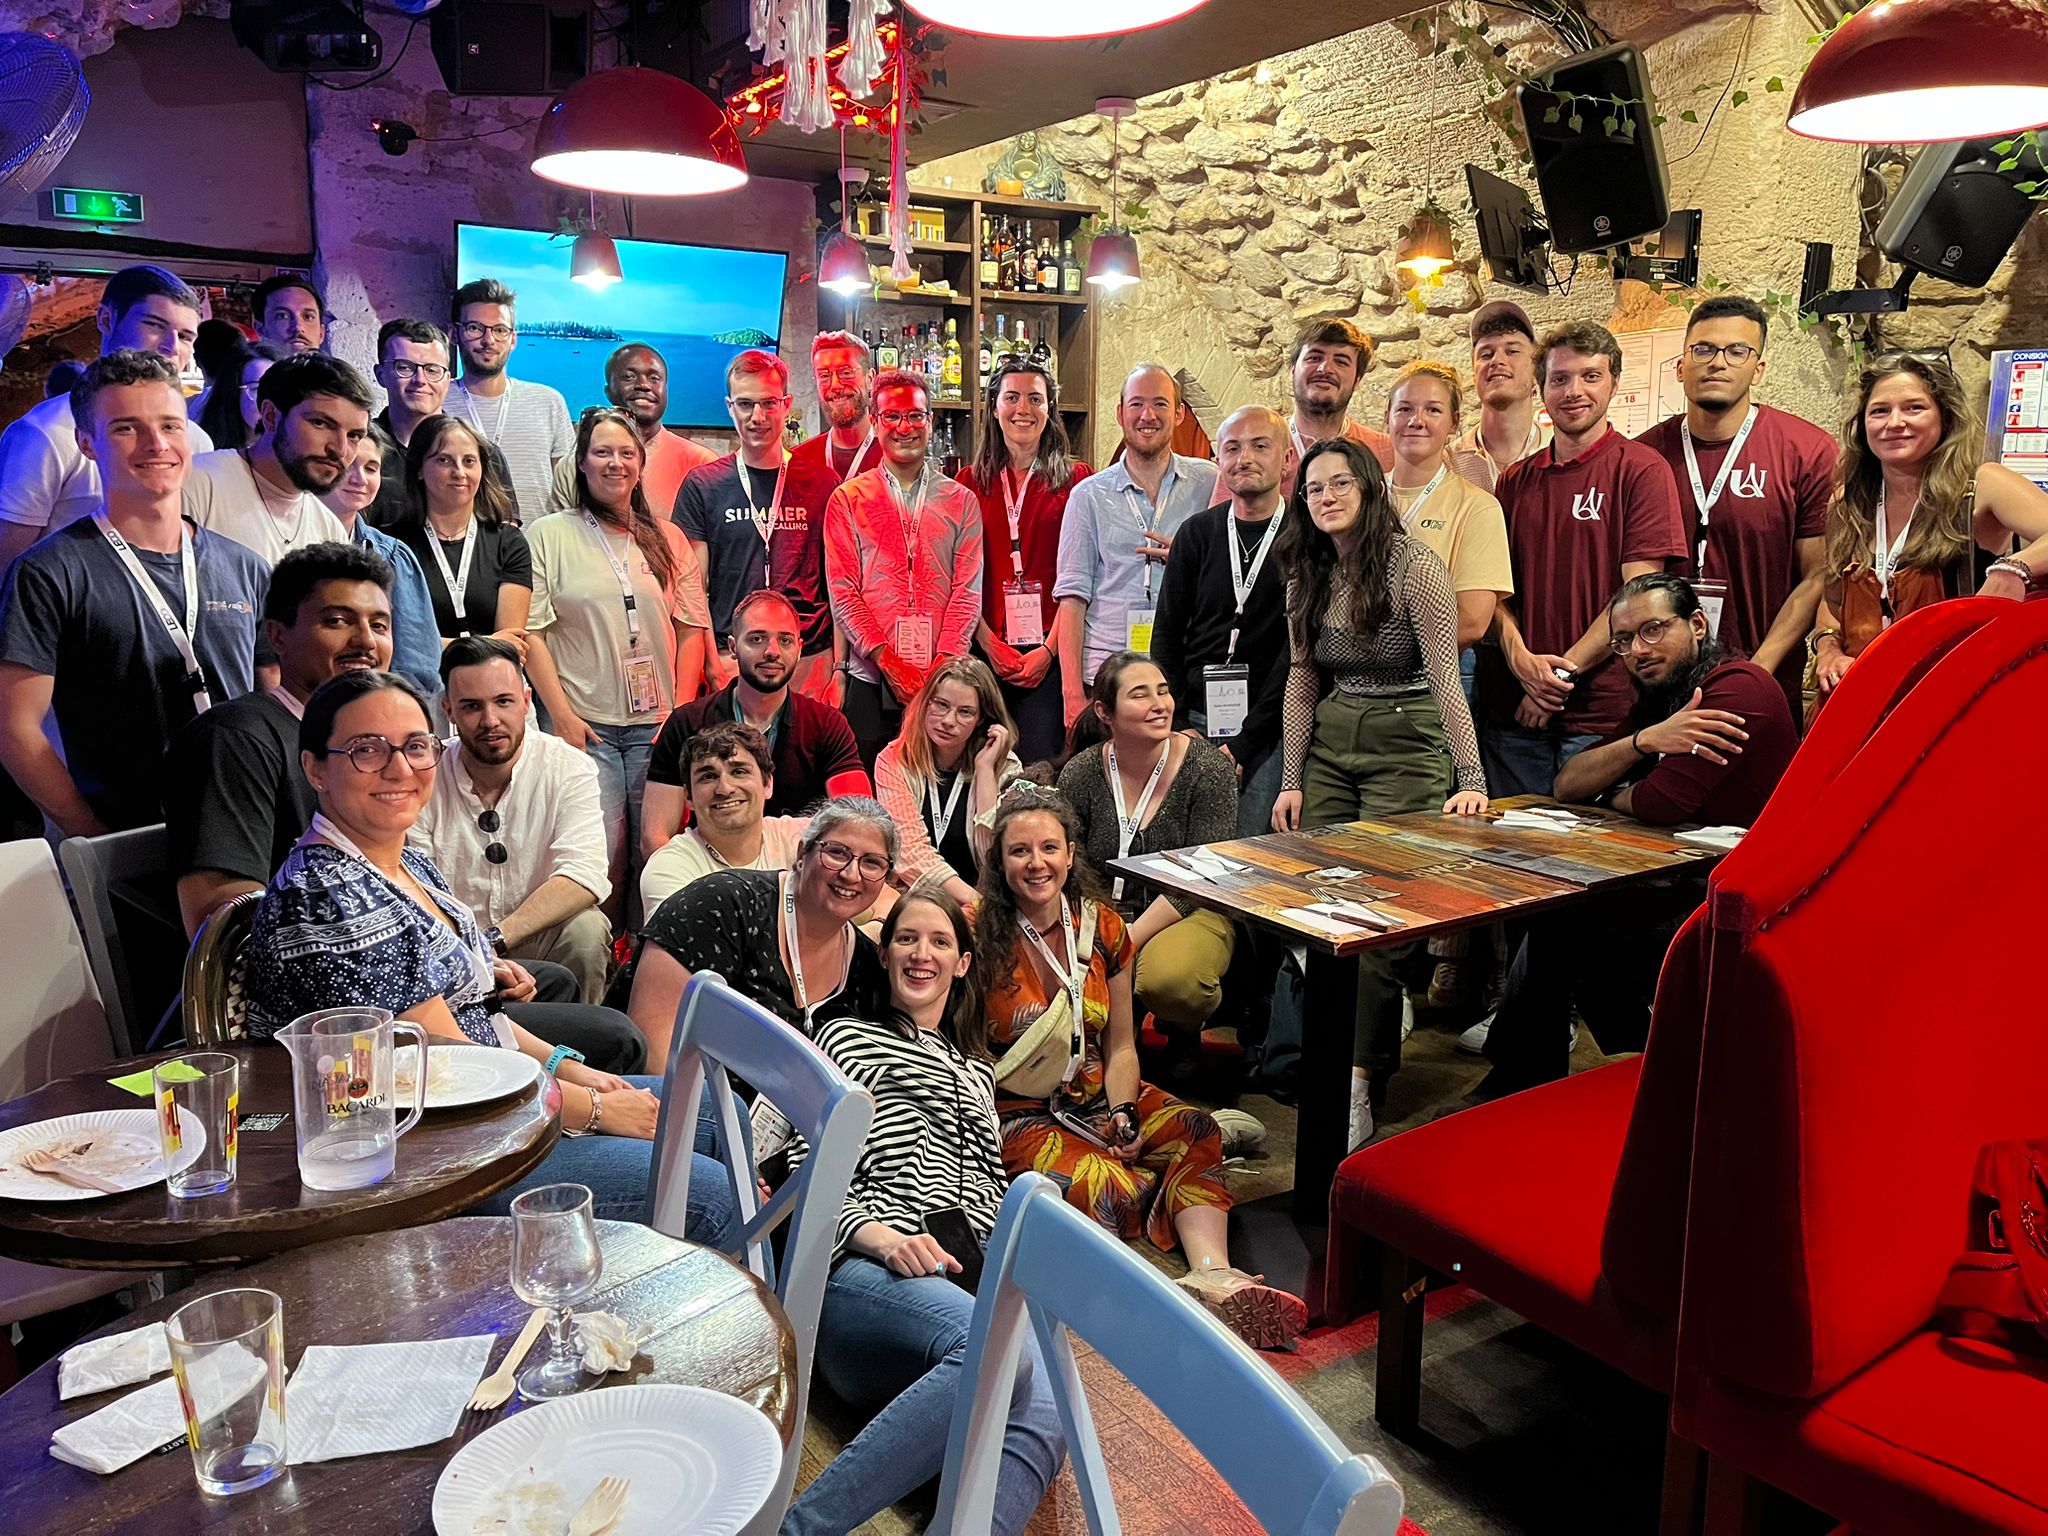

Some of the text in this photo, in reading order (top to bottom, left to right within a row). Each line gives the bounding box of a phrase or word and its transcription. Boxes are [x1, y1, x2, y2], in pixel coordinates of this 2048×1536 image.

[1624, 394, 1636, 404] 18
[1739, 418, 1753, 436] LECO
[1423, 481, 1437, 495] LECO
[1711, 478, 1723, 497] LECO
[1270, 516, 1281, 533] LECO
[107, 530, 127, 552] LECO
[1234, 571, 1242, 589] LECO
[1246, 572, 1257, 590] LECO
[160, 607, 178, 632] LECO
[1109, 754, 1117, 772] LECO
[1154, 758, 1165, 776] LECO
[1128, 817, 1139, 835] LECO
[785, 893, 794, 914] LECO
[1024, 924, 1040, 942] LECO
[920, 1037, 939, 1054] LECO
[327, 1093, 385, 1114] BACARDI
